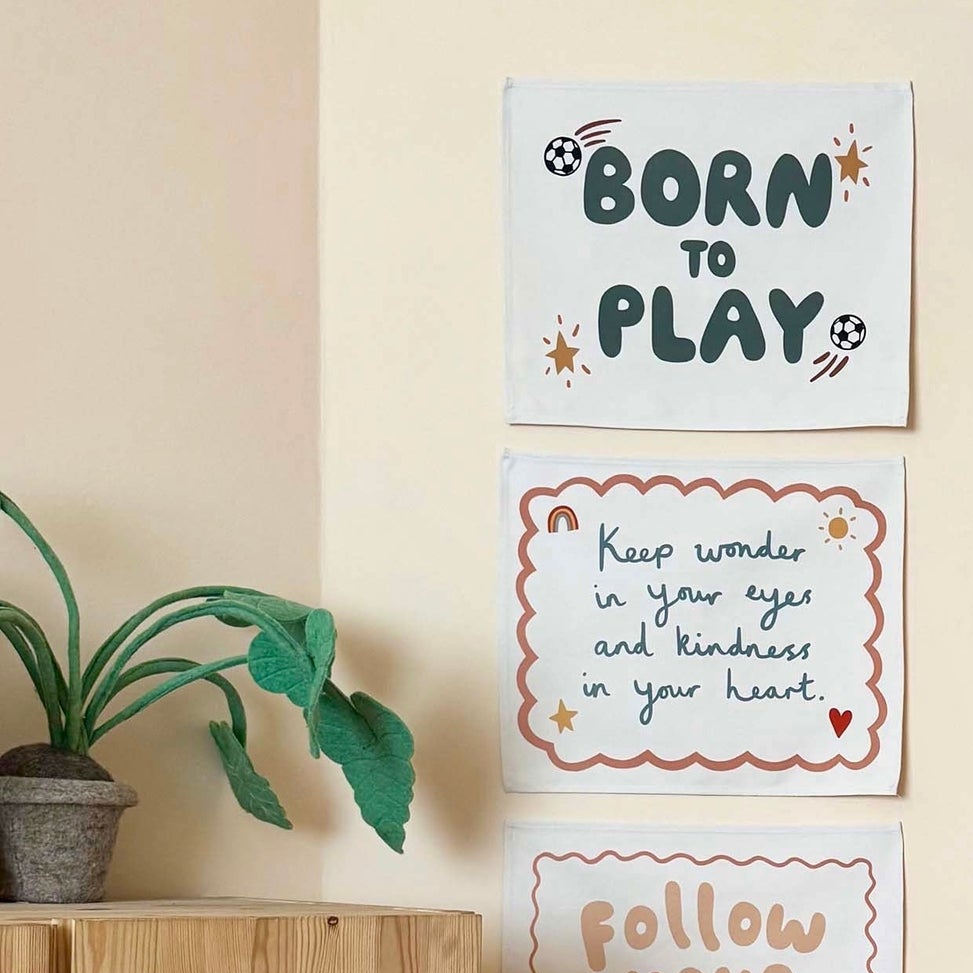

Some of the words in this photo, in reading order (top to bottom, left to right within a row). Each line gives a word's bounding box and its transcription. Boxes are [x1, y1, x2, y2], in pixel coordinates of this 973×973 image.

[583, 145, 833, 229] BORN
[679, 239, 736, 278] TO
[597, 283, 825, 364] PLAY
[599, 522, 674, 572] Keep
[694, 530, 806, 563] wonder
[593, 584, 626, 610] in
[647, 583, 723, 628] your
[744, 583, 812, 631] eyes
[593, 621, 655, 658] and
[675, 626, 812, 662] kindness
[582, 671, 610, 698] in
[633, 678, 701, 726] your
[726, 668, 825, 702] heart.
